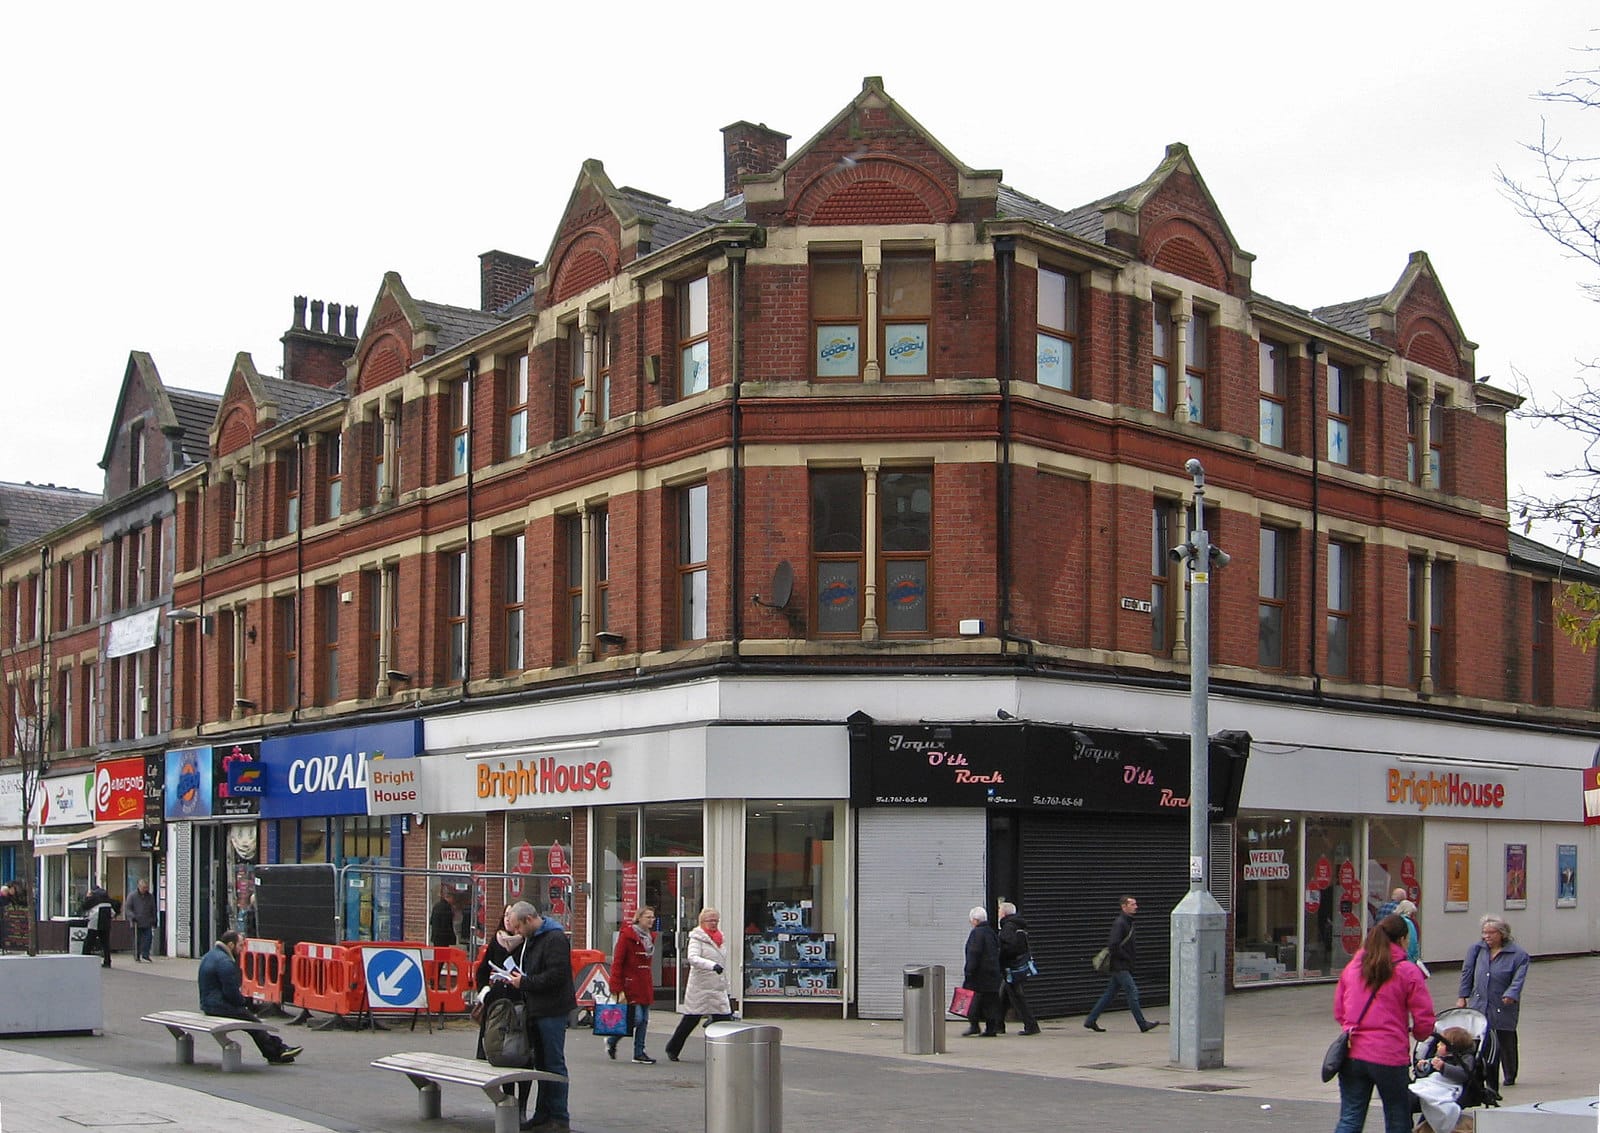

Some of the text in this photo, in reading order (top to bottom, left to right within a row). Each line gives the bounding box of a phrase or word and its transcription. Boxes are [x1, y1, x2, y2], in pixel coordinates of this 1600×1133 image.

[927, 751, 969, 766] O'th
[288, 751, 369, 794] CORAL
[373, 770, 415, 785] Bright
[955, 769, 1004, 783] Rock
[374, 790, 417, 802] House
[1160, 788, 1191, 808] Roc
[442, 850, 467, 860] WEEKLY
[1251, 851, 1283, 863] WEEKLY
[1245, 865, 1290, 878] PAYMENTS
[781, 911, 799, 922] 3D
[759, 945, 777, 955] 3D
[805, 945, 823, 955] 3D
[758, 978, 776, 988] 3D
[807, 978, 824, 988] 3D
